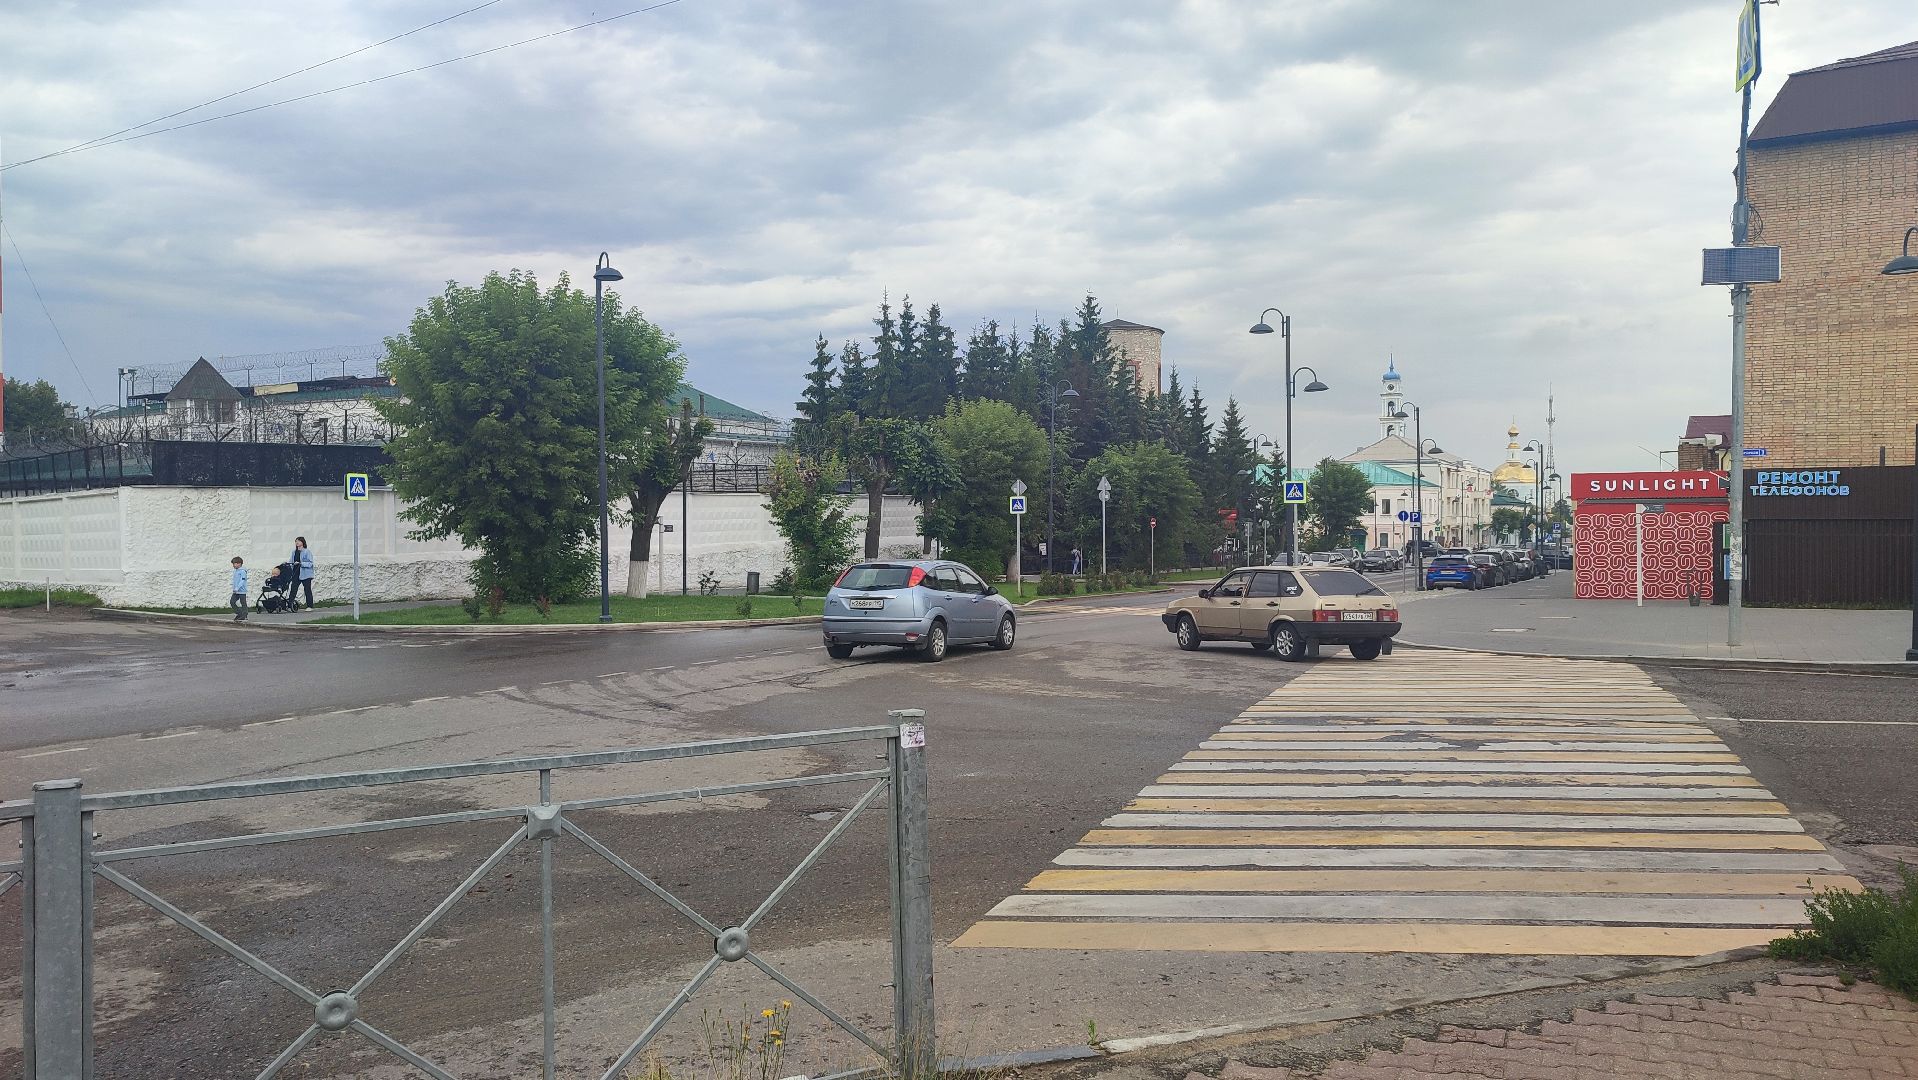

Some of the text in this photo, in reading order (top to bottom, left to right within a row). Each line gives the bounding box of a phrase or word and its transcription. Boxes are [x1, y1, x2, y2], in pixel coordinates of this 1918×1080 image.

[1757, 470, 1840, 484] РЕМОНТ
[1590, 479, 1710, 492] SUNLIGHT
[1749, 485, 1850, 496] ТЕЛЕФОНОВ
